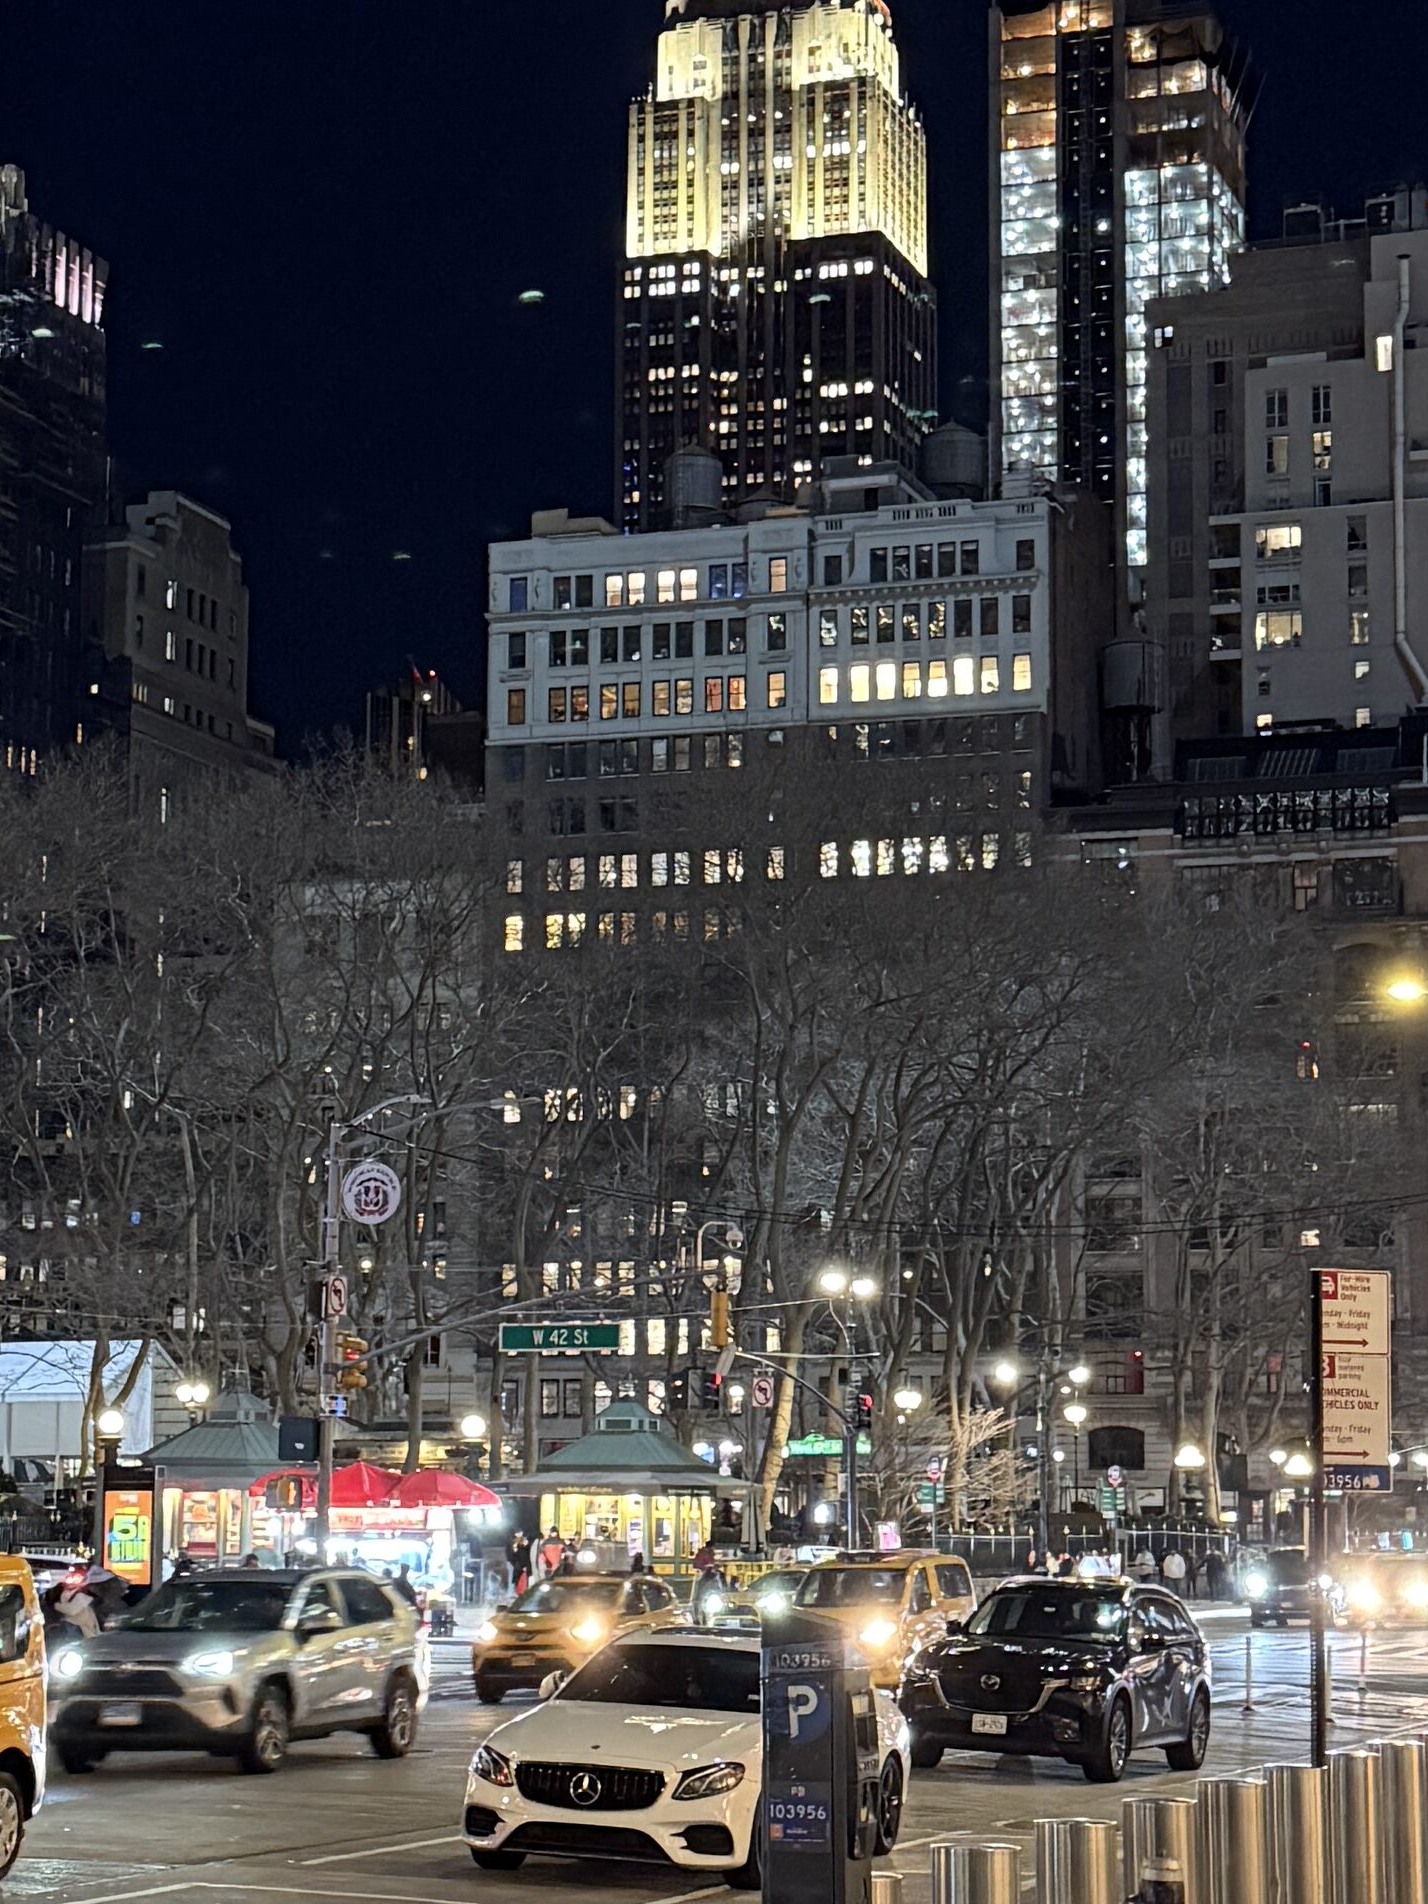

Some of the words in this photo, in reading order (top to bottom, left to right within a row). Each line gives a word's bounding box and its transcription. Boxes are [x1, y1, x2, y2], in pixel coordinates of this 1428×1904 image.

[1340, 1293, 1357, 1302] Only
[1349, 1309, 1371, 1319] Friday
[532, 1329, 545, 1346] W
[549, 1328, 569, 1345] 42
[574, 1328, 589, 1345] St
[1323, 1400, 1355, 1410] HICLES
[1358, 1400, 1380, 1410] ONLY
[1349, 1424, 1372, 1435] Friday
[775, 1653, 832, 1668] 103956
[787, 1684, 819, 1739] P
[769, 1803, 827, 1820] 103956
